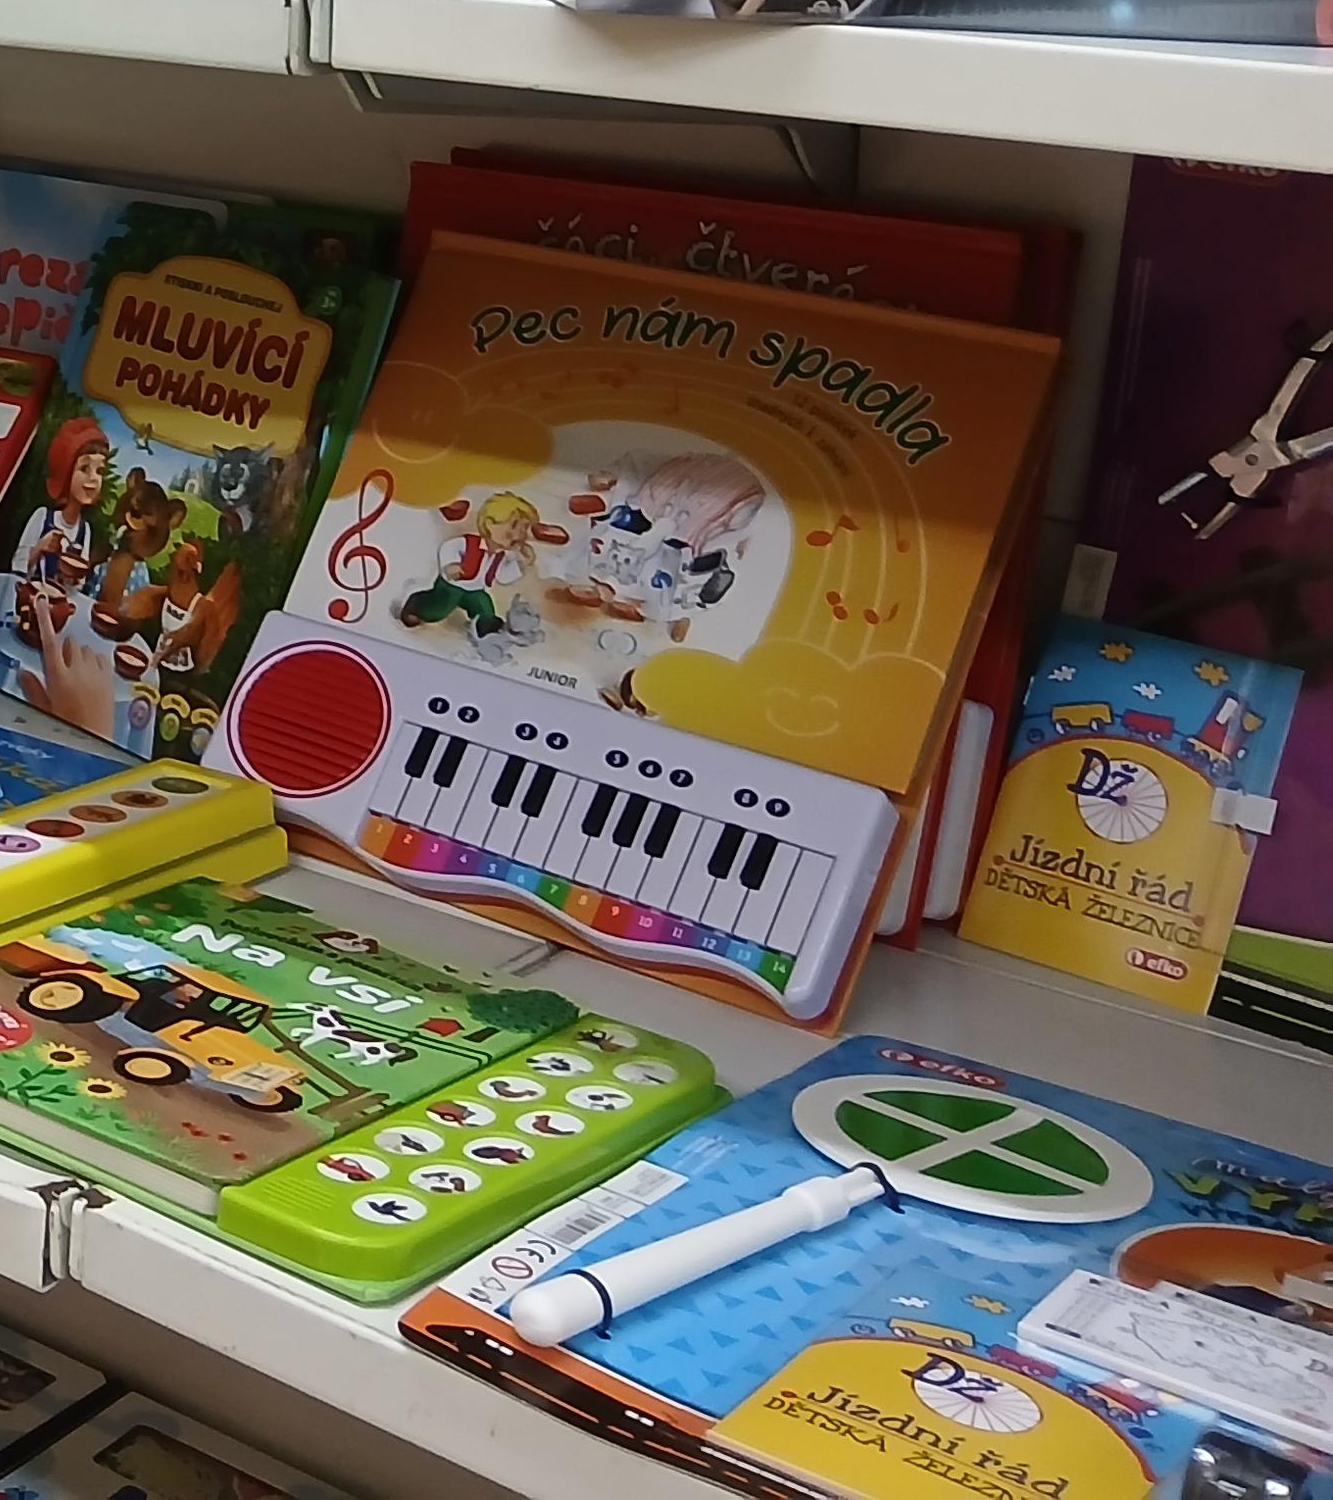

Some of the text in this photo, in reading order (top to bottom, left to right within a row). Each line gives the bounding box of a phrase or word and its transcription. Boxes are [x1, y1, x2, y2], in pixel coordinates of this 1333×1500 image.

[112, 295, 311, 390] MLUVÍCÍ
[115, 356, 272, 430] POHÁDKY
[471, 300, 582, 355] Pec
[600, 296, 736, 359] nám
[747, 330, 952, 467] spadla
[526, 666, 579, 691] JUNIOR
[1010, 834, 1195, 914] Jízdní řád
[1081, 892, 1202, 950] ŽELEZNICE
[170, 923, 290, 969] Na
[307, 965, 425, 1014] vsi
[1145, 956, 1187, 979] efko
[915, 1058, 1000, 1086] efko
[806, 1385, 1070, 1500] Jízdní řád
